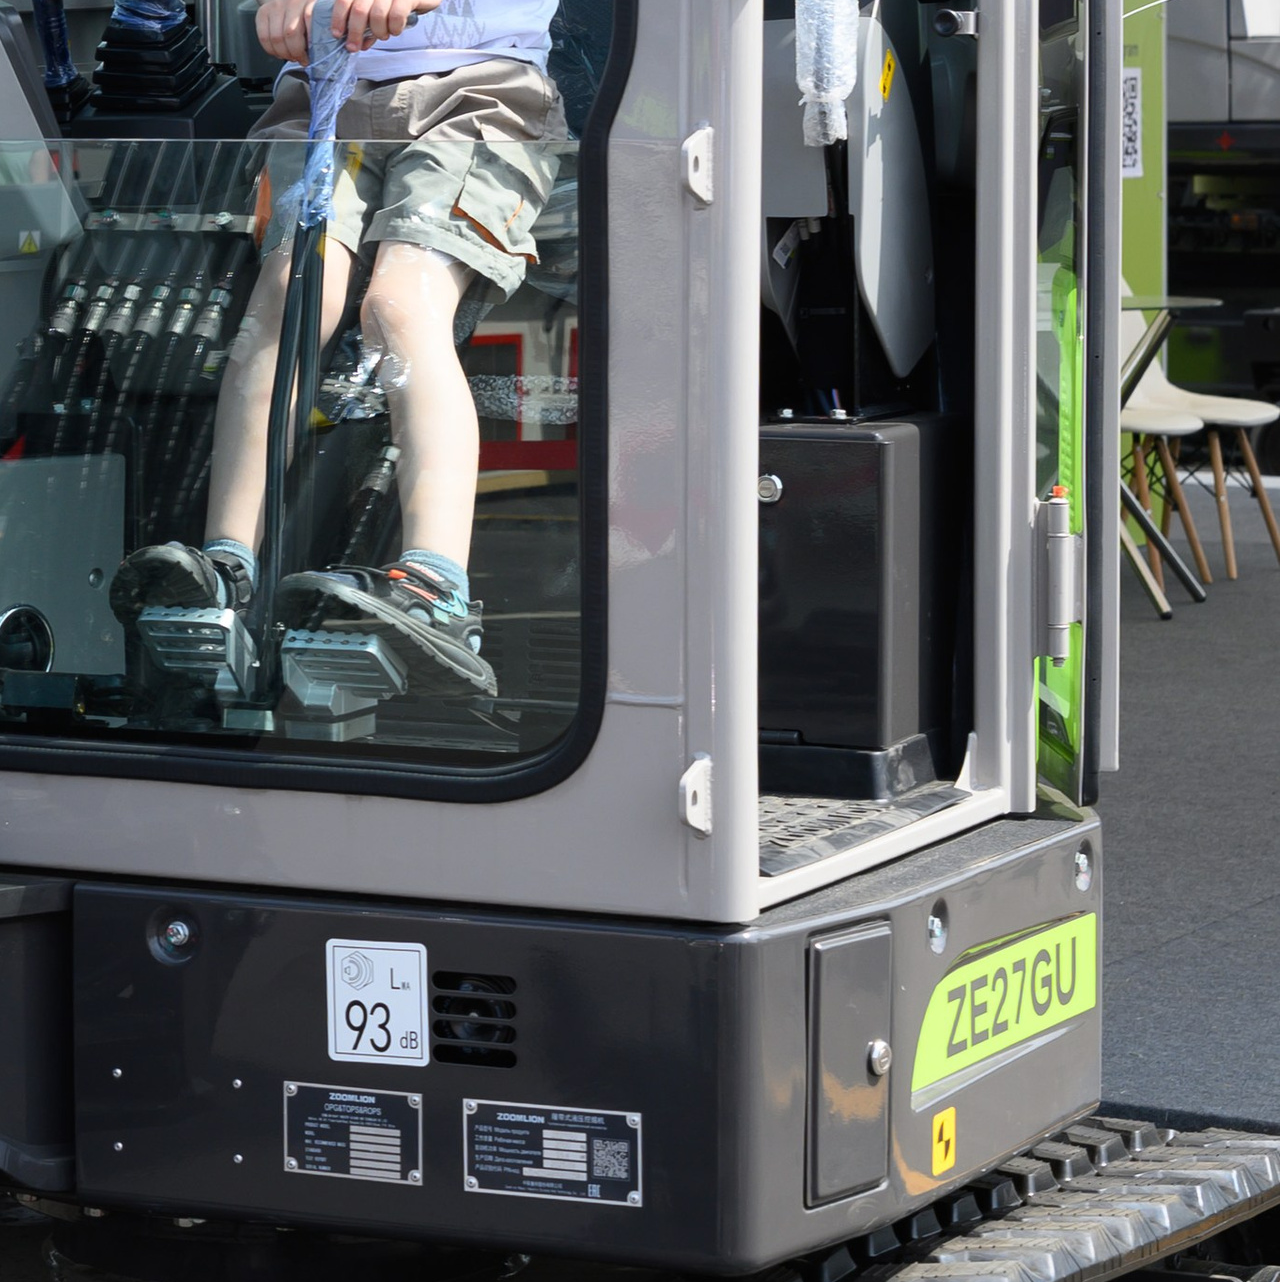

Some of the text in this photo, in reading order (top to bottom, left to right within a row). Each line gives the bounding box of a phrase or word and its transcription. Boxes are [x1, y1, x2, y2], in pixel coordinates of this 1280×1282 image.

[946, 936, 1077, 1059] ZE27GU
[345, 999, 419, 1053] 93 dB
[329, 1092, 376, 1104] ZOOMLION
[496, 1112, 545, 1124] ZOOMLION
